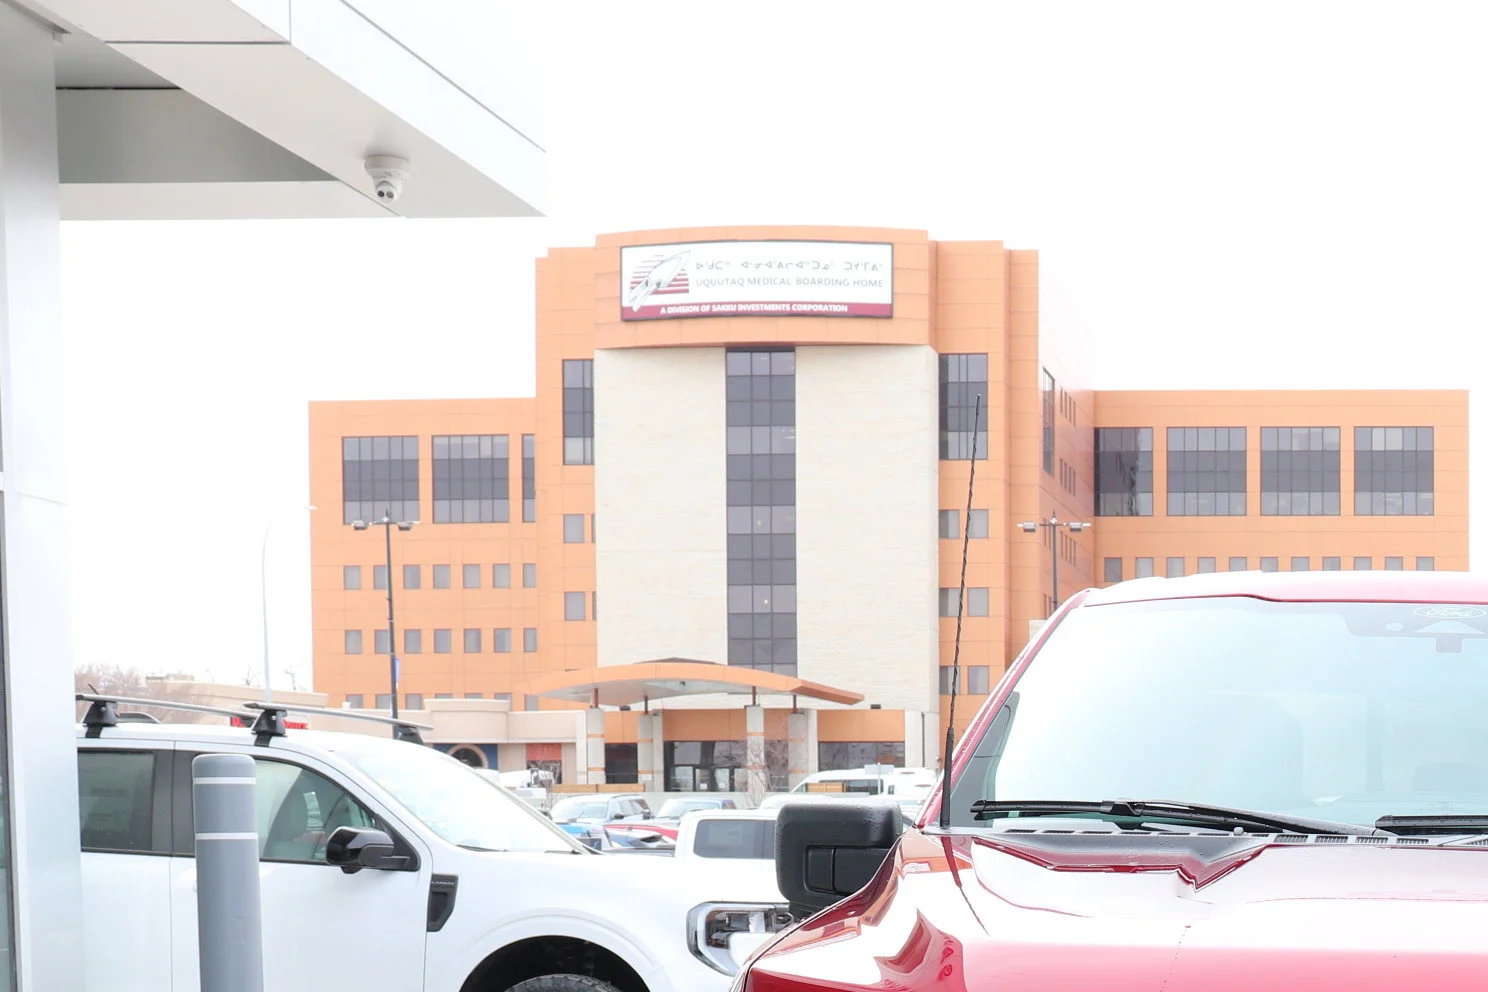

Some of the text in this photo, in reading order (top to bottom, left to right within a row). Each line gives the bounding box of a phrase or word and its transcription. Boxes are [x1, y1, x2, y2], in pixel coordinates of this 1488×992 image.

[696, 276, 883, 289] UQUUTAQ MEDICAL BOARDING HOME
[667, 304, 700, 314] DIVISION
[700, 304, 711, 313] OF
[737, 303, 791, 312] INVESTMENTS
[791, 303, 848, 313] CORPORATION
